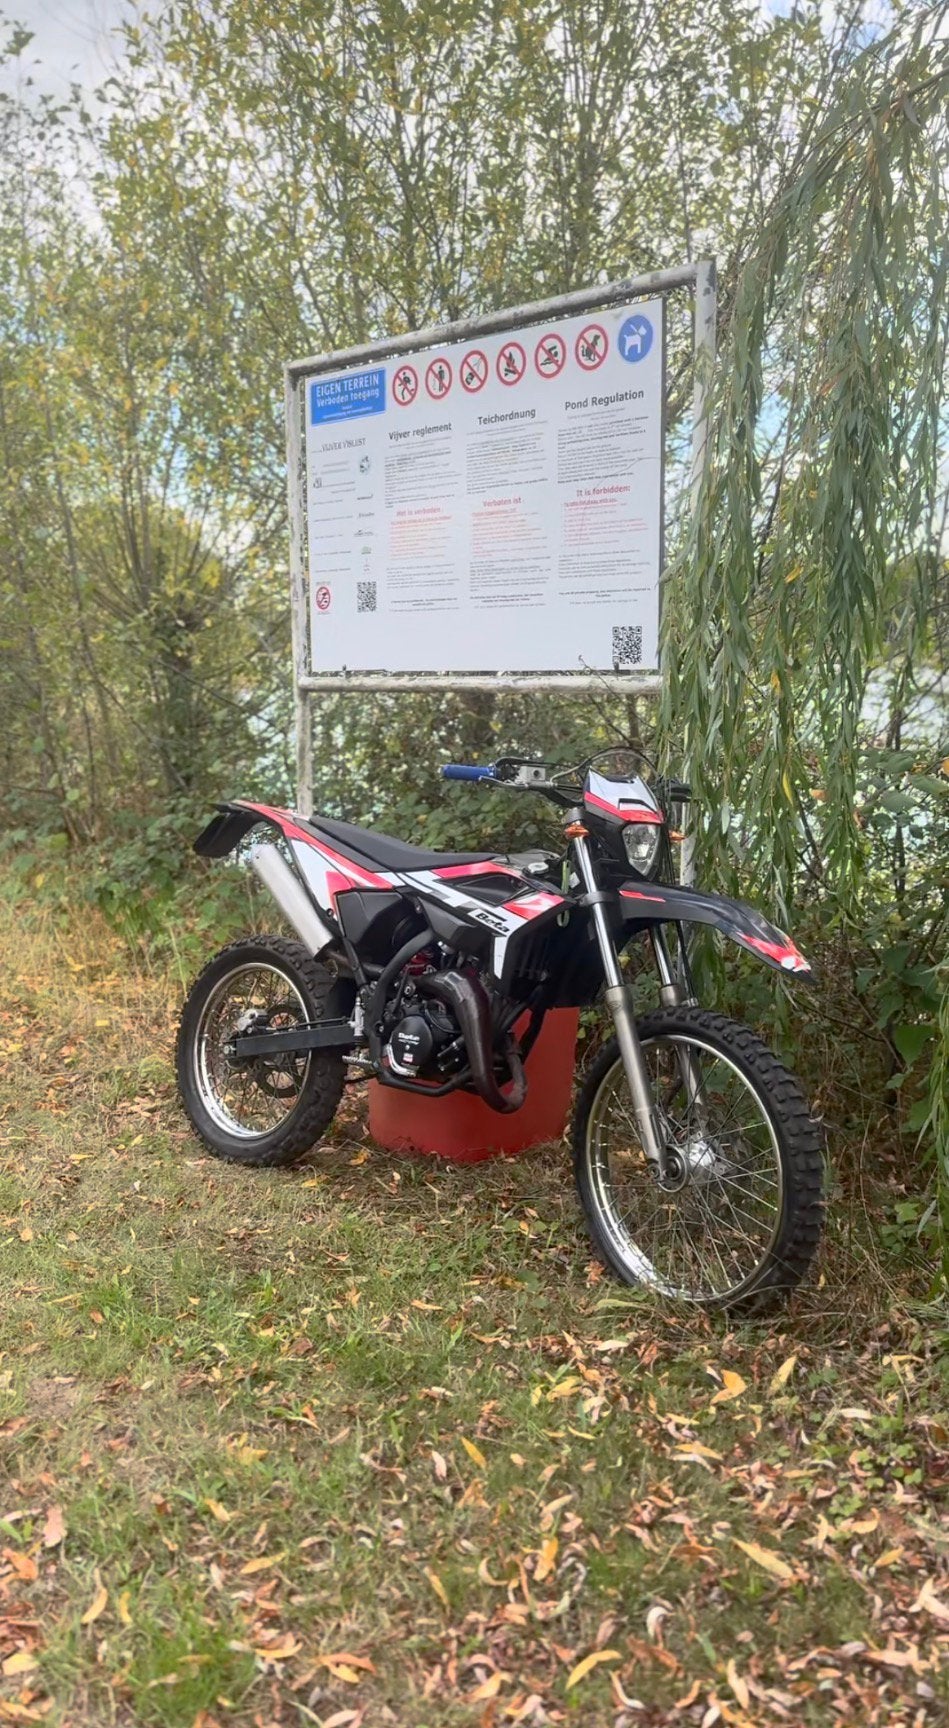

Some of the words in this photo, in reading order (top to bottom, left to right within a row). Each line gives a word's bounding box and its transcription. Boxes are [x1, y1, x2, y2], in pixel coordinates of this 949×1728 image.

[316, 382, 341, 397] EIGEN
[344, 373, 379, 391] TERREIN
[317, 394, 349, 407] Verboden
[350, 388, 380, 401] toegang
[565, 398, 589, 411] Pond
[591, 390, 645, 406] Regulation
[478, 409, 536, 425] Teichordnung
[388, 430, 411, 441] Vijver
[412, 422, 452, 437] reglement
[576, 489, 583, 497] It
[584, 488, 592, 496] is
[592, 485, 631, 495] forbidden:
[475, 912, 510, 932] Beta
